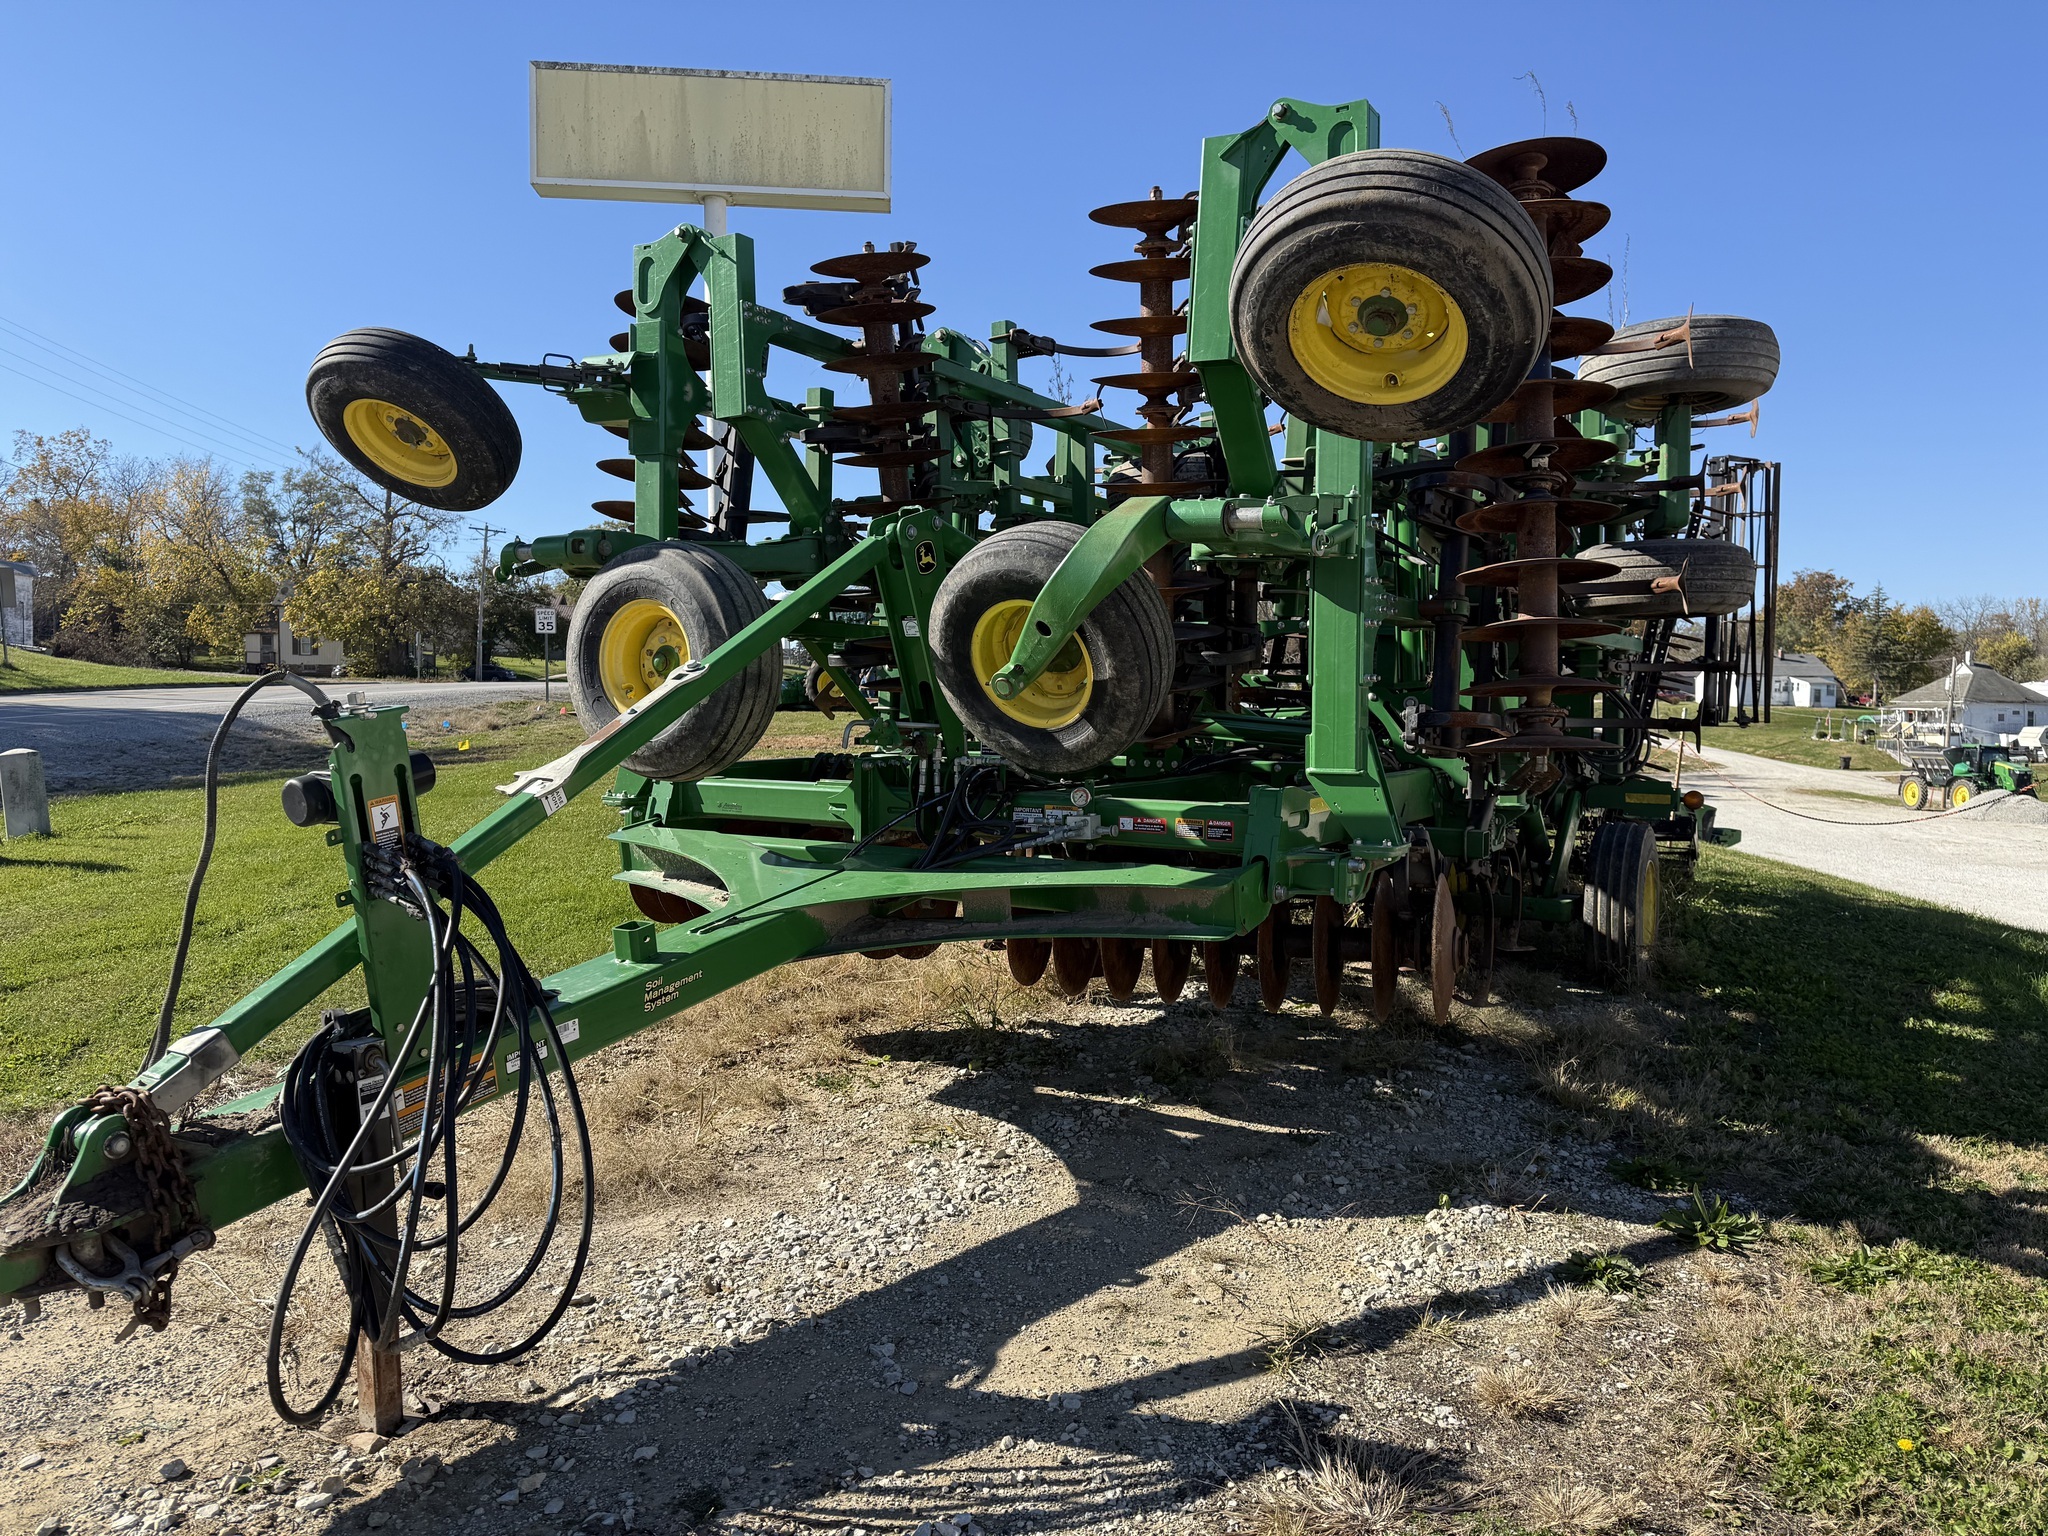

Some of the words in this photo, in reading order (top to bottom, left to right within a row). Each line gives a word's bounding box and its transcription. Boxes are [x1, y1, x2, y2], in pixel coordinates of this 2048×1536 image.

[538, 622, 554, 630] 35
[374, 796, 396, 805] WARNING
[644, 969, 703, 1002] Management
[645, 976, 663, 991] Soil
[643, 990, 679, 1012] System
[506, 1039, 546, 1062] IMPNT
